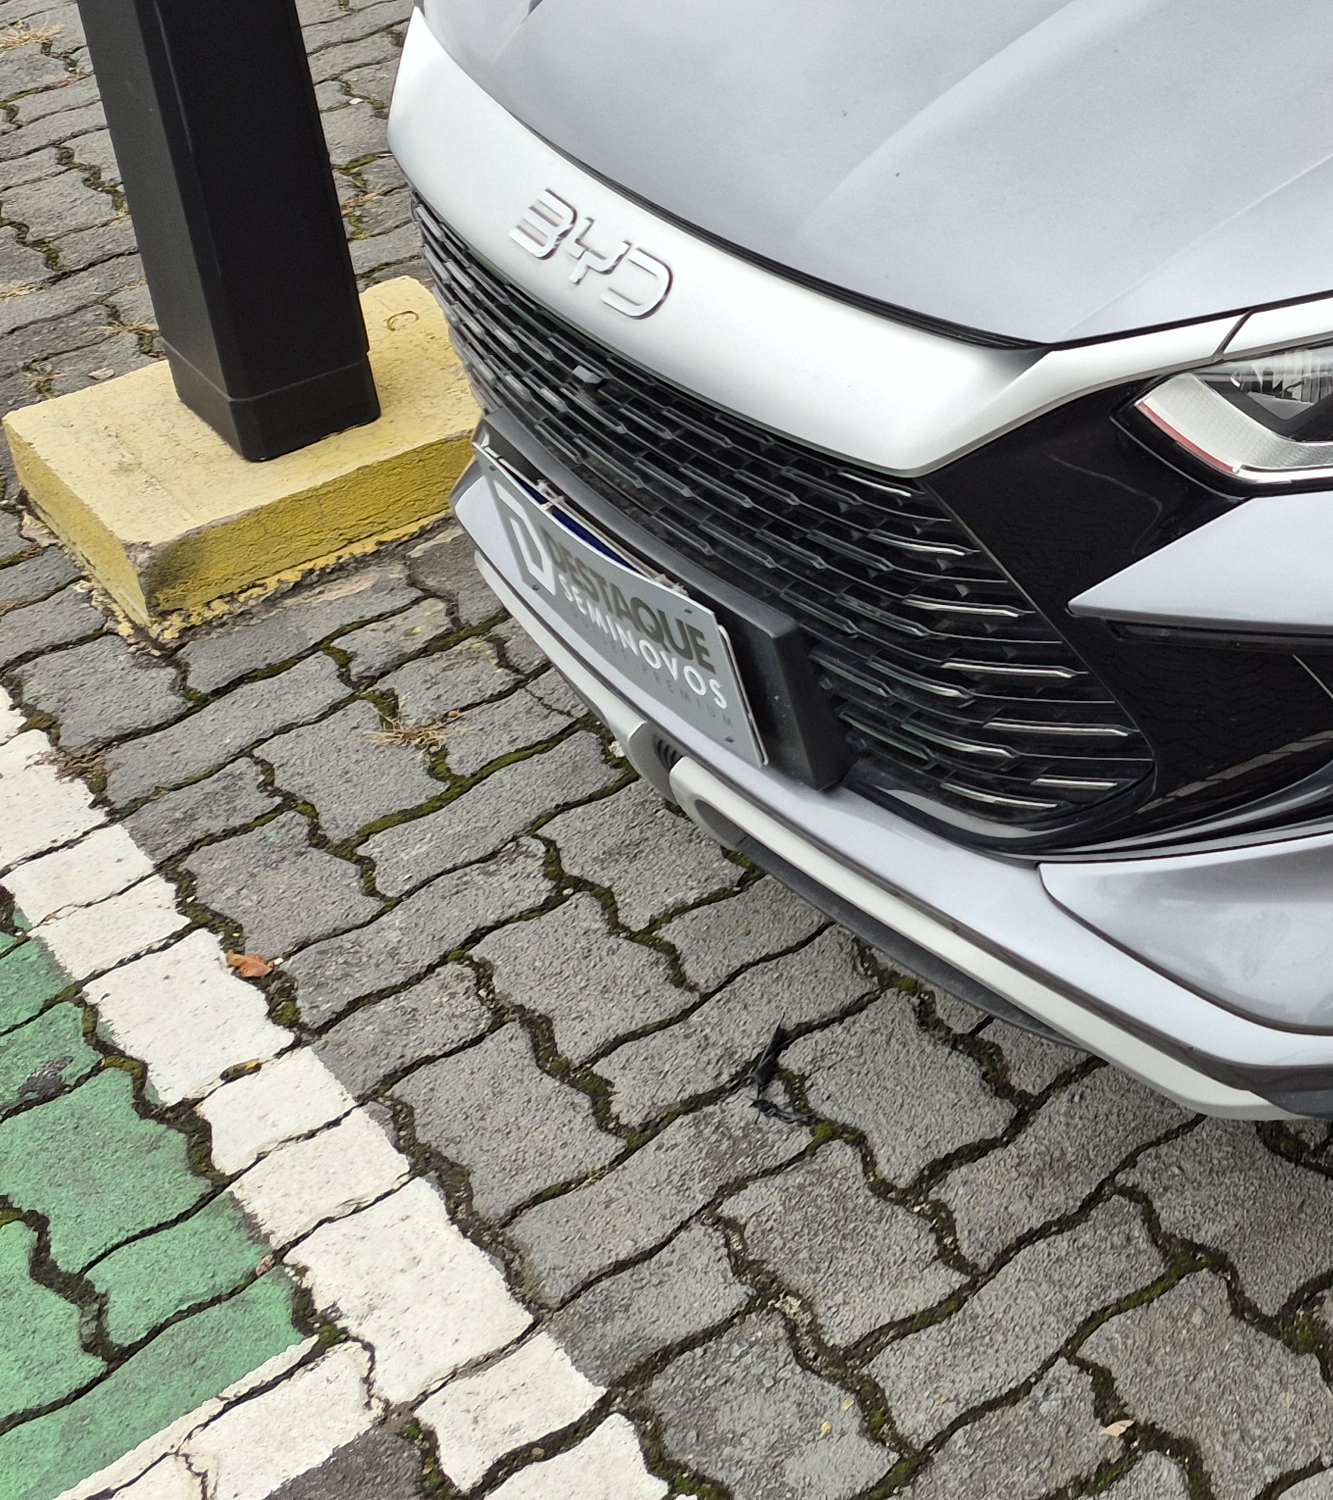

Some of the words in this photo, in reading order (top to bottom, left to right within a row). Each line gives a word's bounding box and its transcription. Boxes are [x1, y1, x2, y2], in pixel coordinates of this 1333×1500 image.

[508, 187, 674, 321] BYD
[540, 526, 717, 676] DESTAQUE
[557, 573, 728, 711] SEMINOVOS
